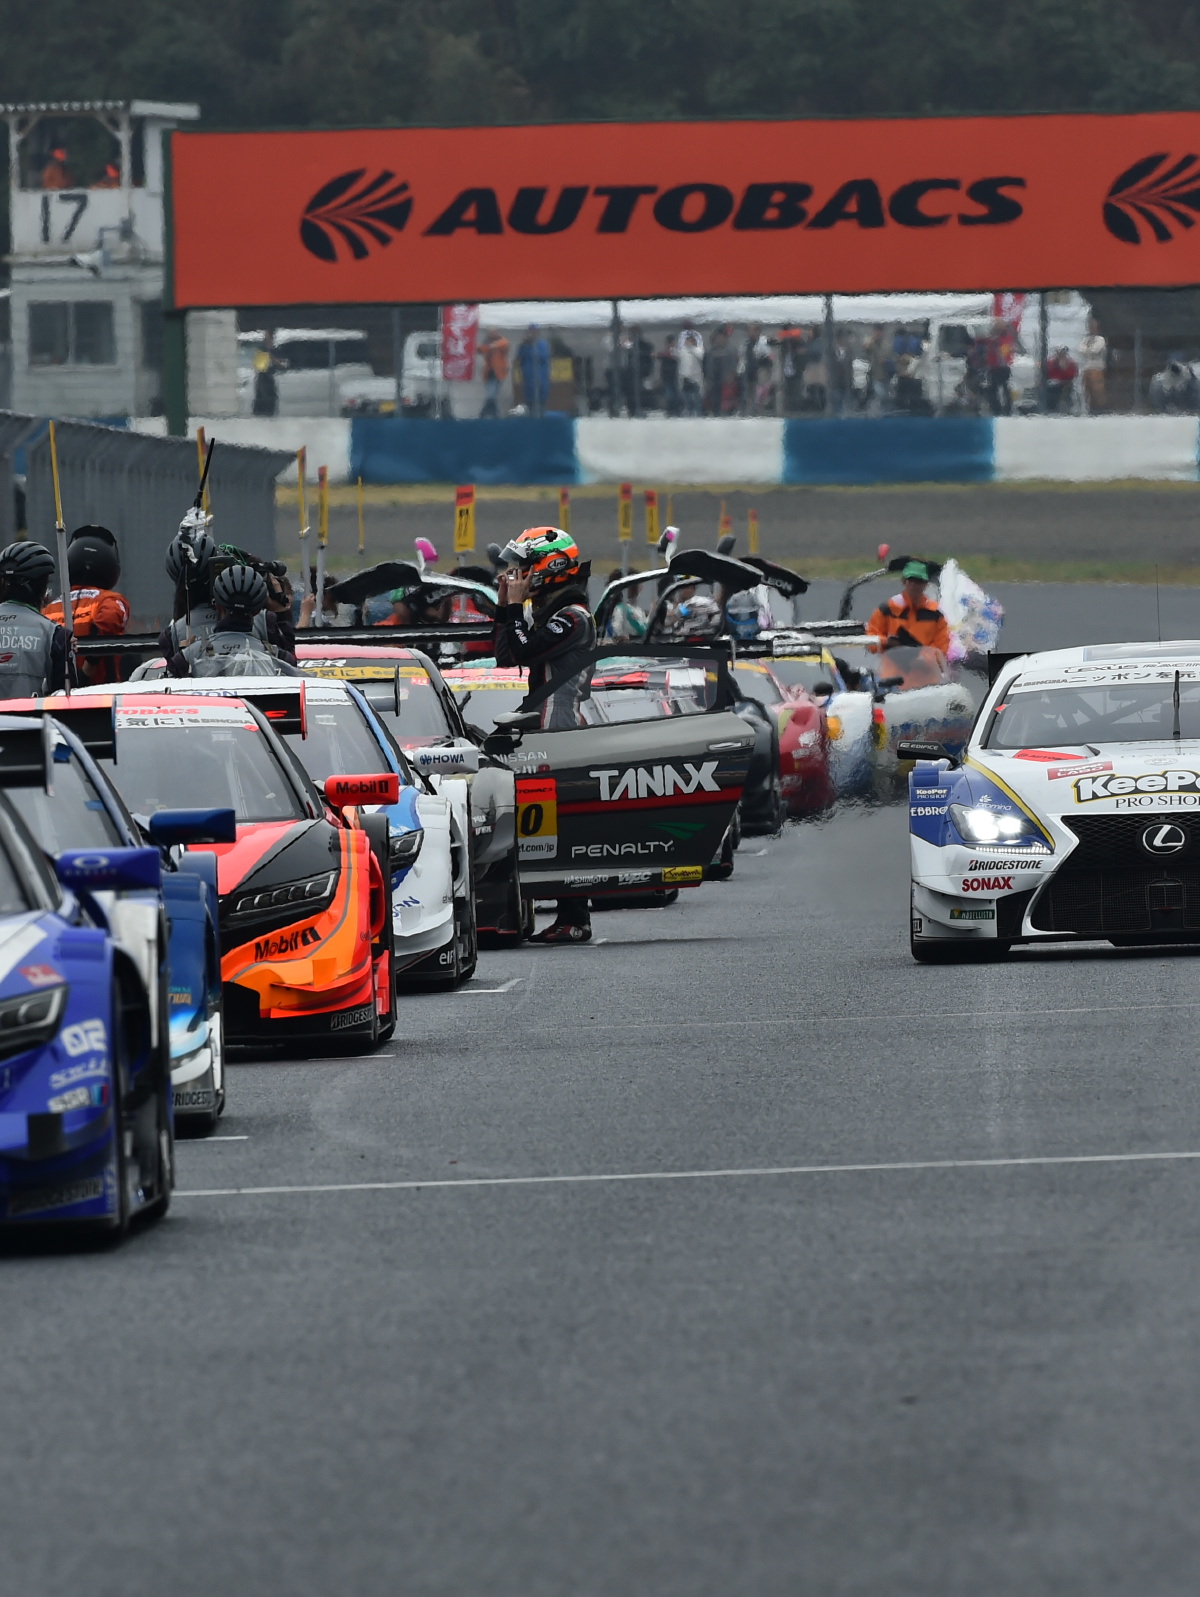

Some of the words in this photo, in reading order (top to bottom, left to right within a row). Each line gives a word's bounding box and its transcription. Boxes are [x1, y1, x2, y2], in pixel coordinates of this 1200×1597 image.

[424, 176, 1026, 236] AUTOBACS
[41, 193, 88, 242] 17
[433, 754, 465, 764] HOWA
[493, 751, 548, 763] NISSAN
[588, 760, 722, 800] TANAX
[336, 781, 376, 794] Mobil
[1116, 796, 1154, 808] PRO
[910, 806, 949, 817] EBBRO
[572, 840, 674, 859] PENALTY
[968, 860, 1043, 872] BRIDGESTONE
[962, 876, 1013, 892] SONAX
[255, 931, 299, 960] Mobil
